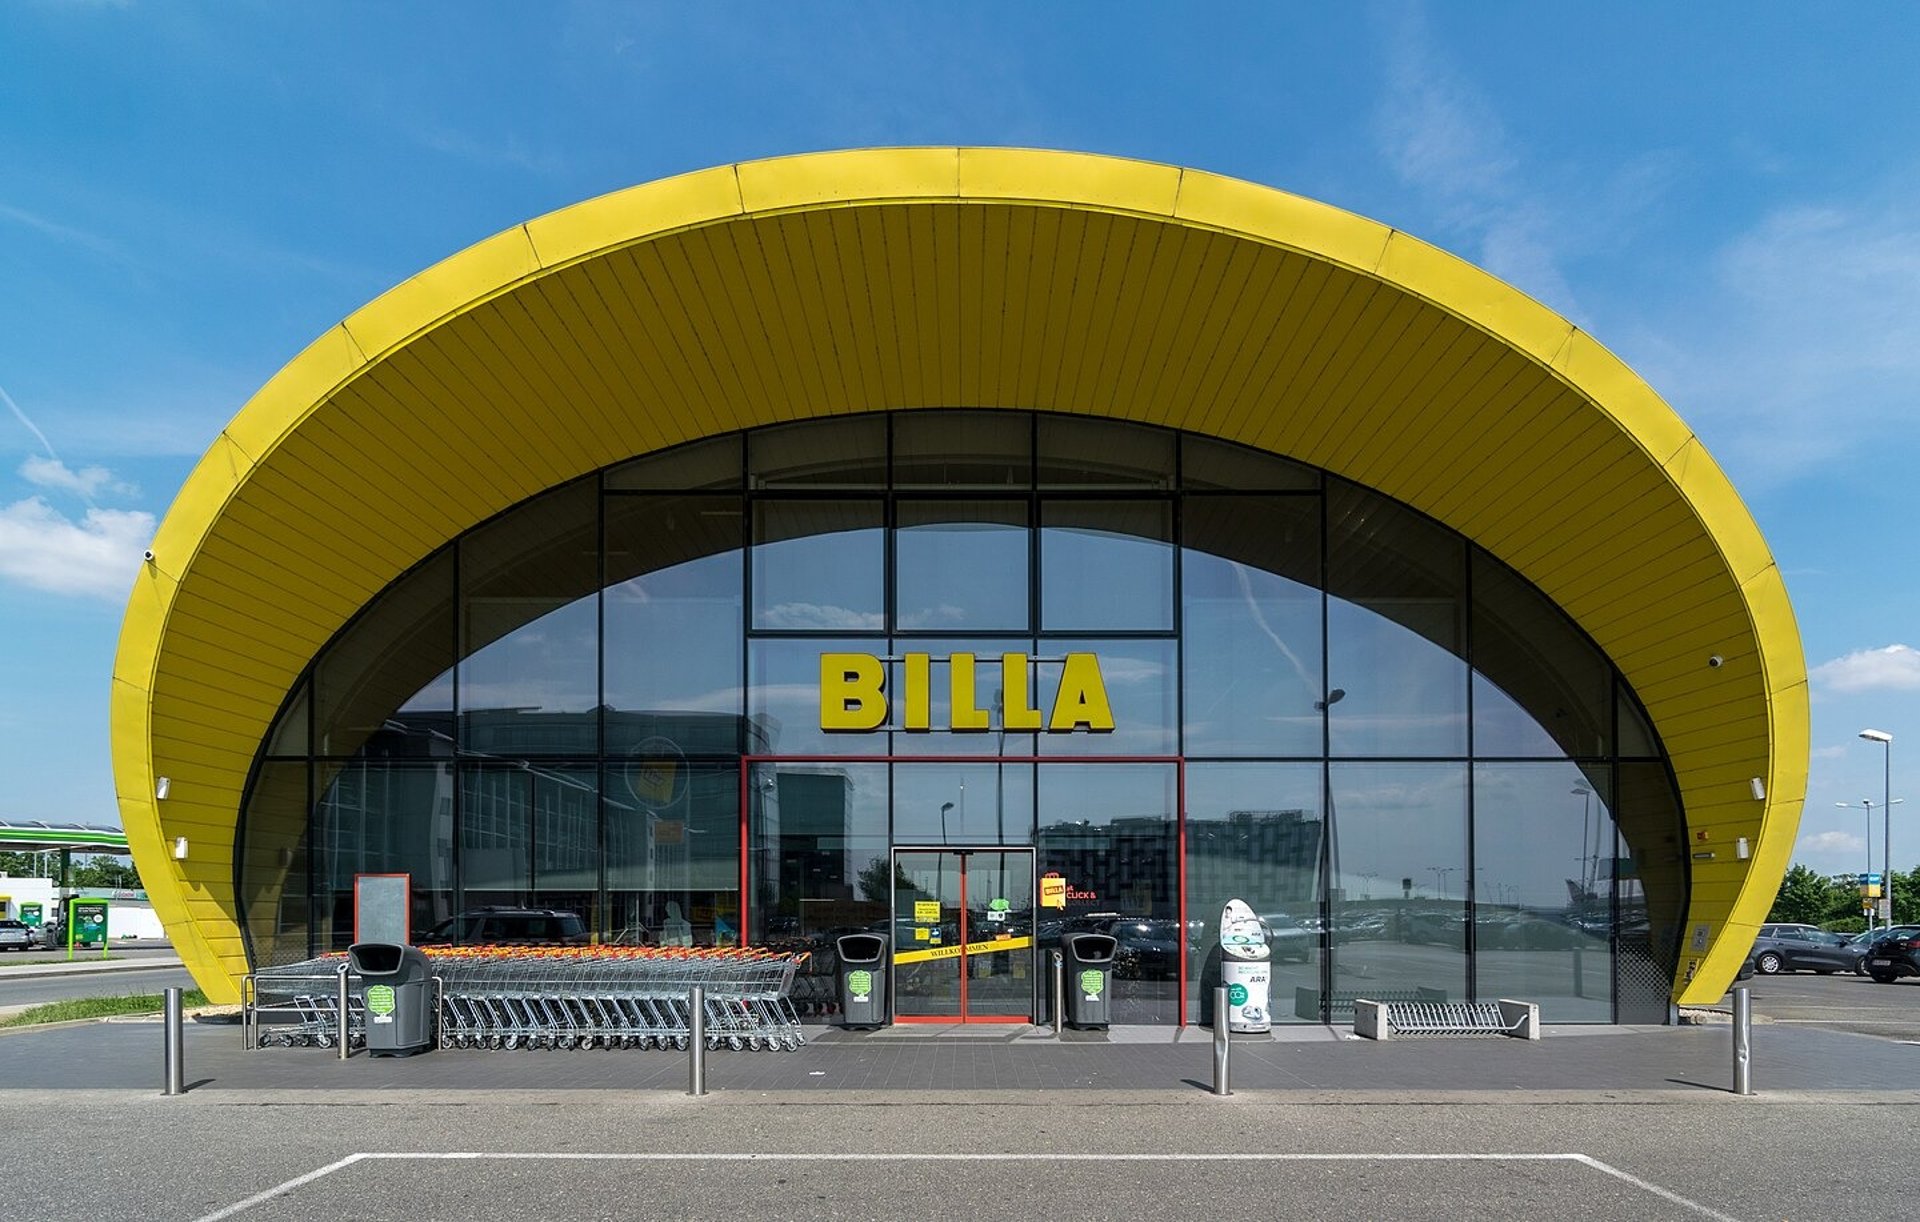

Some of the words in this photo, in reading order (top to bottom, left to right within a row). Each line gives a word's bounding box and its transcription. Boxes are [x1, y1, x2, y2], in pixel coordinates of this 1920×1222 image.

[820, 652, 1115, 733] BILLA
[1066, 891, 1089, 899] CLICK
[1090, 891, 1097, 899] &
